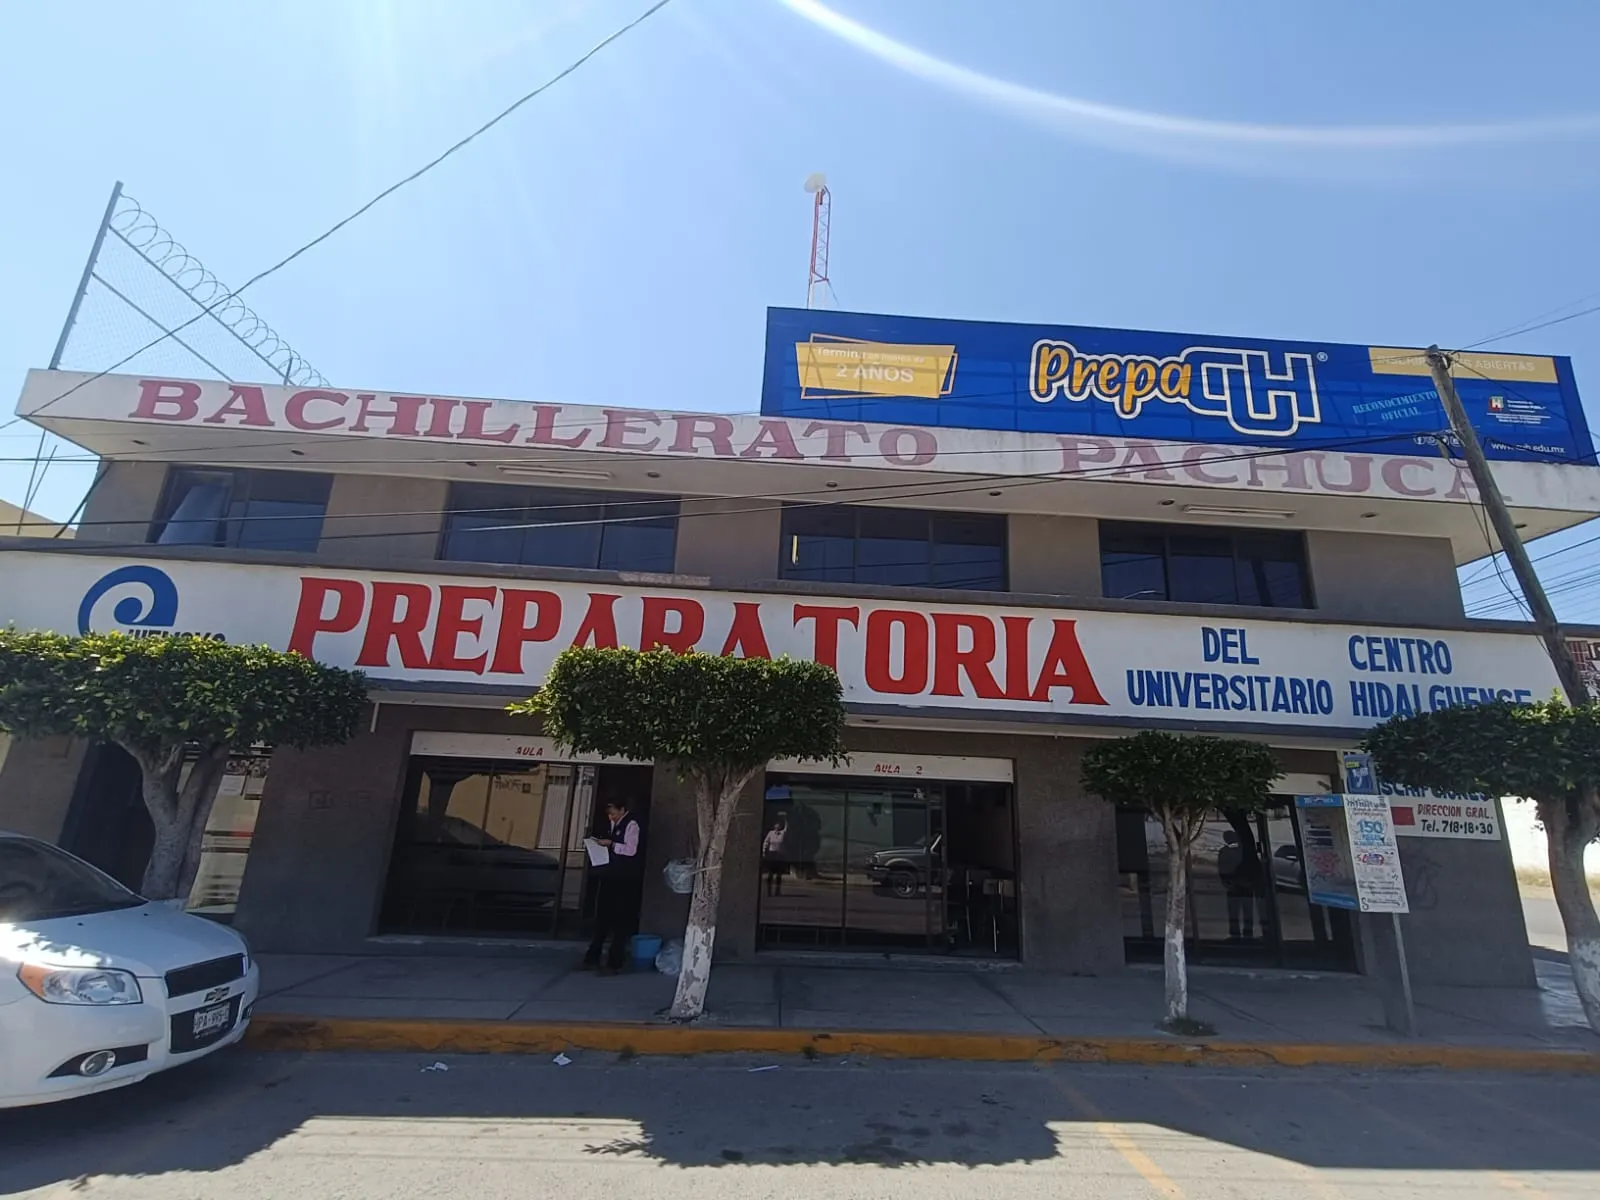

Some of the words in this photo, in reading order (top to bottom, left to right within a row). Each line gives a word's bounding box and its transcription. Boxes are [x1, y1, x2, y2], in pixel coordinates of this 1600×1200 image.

[835, 363, 848, 378] 2
[853, 361, 915, 383] AÑOS
[1475, 358, 1536, 372] ABIERTAS
[1033, 342, 1193, 416] Prepa
[1352, 390, 1438, 414] RECONOCIMIENTO
[128, 380, 939, 467] BACHILLERATO
[1381, 406, 1421, 422] OFICIAL
[287, 576, 1111, 706] PREPARATORIA
[1202, 626, 1259, 665] DEL
[1348, 634, 1452, 675] CENTRO
[1126, 669, 1334, 716] UNIVERSITARIO
[516, 746, 543, 757] AULA
[874, 763, 900, 775] AULA
[915, 765, 923, 775] 2
[1417, 803, 1462, 818] DIRECCION
[1465, 806, 1494, 820] GRAL.
[1421, 819, 1440, 833] Tel.
